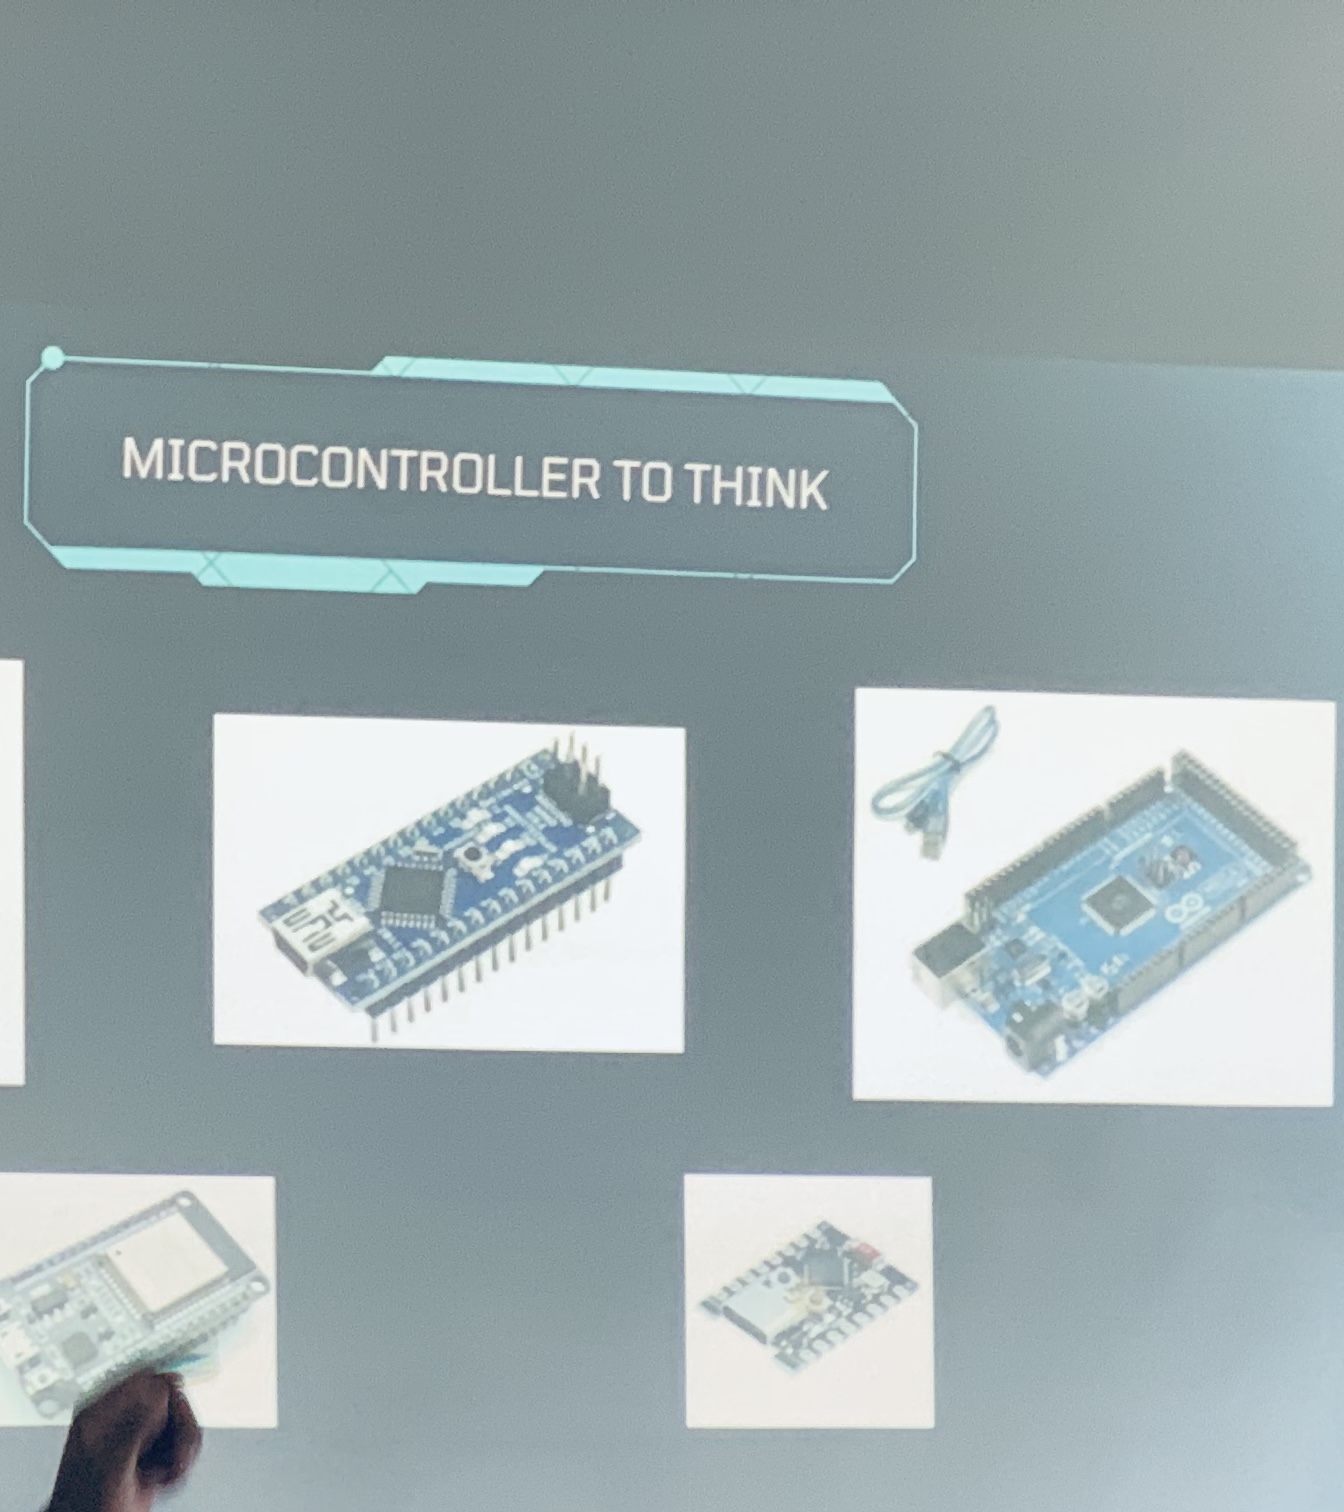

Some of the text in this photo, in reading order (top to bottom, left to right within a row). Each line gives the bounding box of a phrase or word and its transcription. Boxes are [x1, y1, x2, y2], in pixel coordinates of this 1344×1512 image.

[123, 435, 830, 511] MICROCONTROLLER TO THINK
